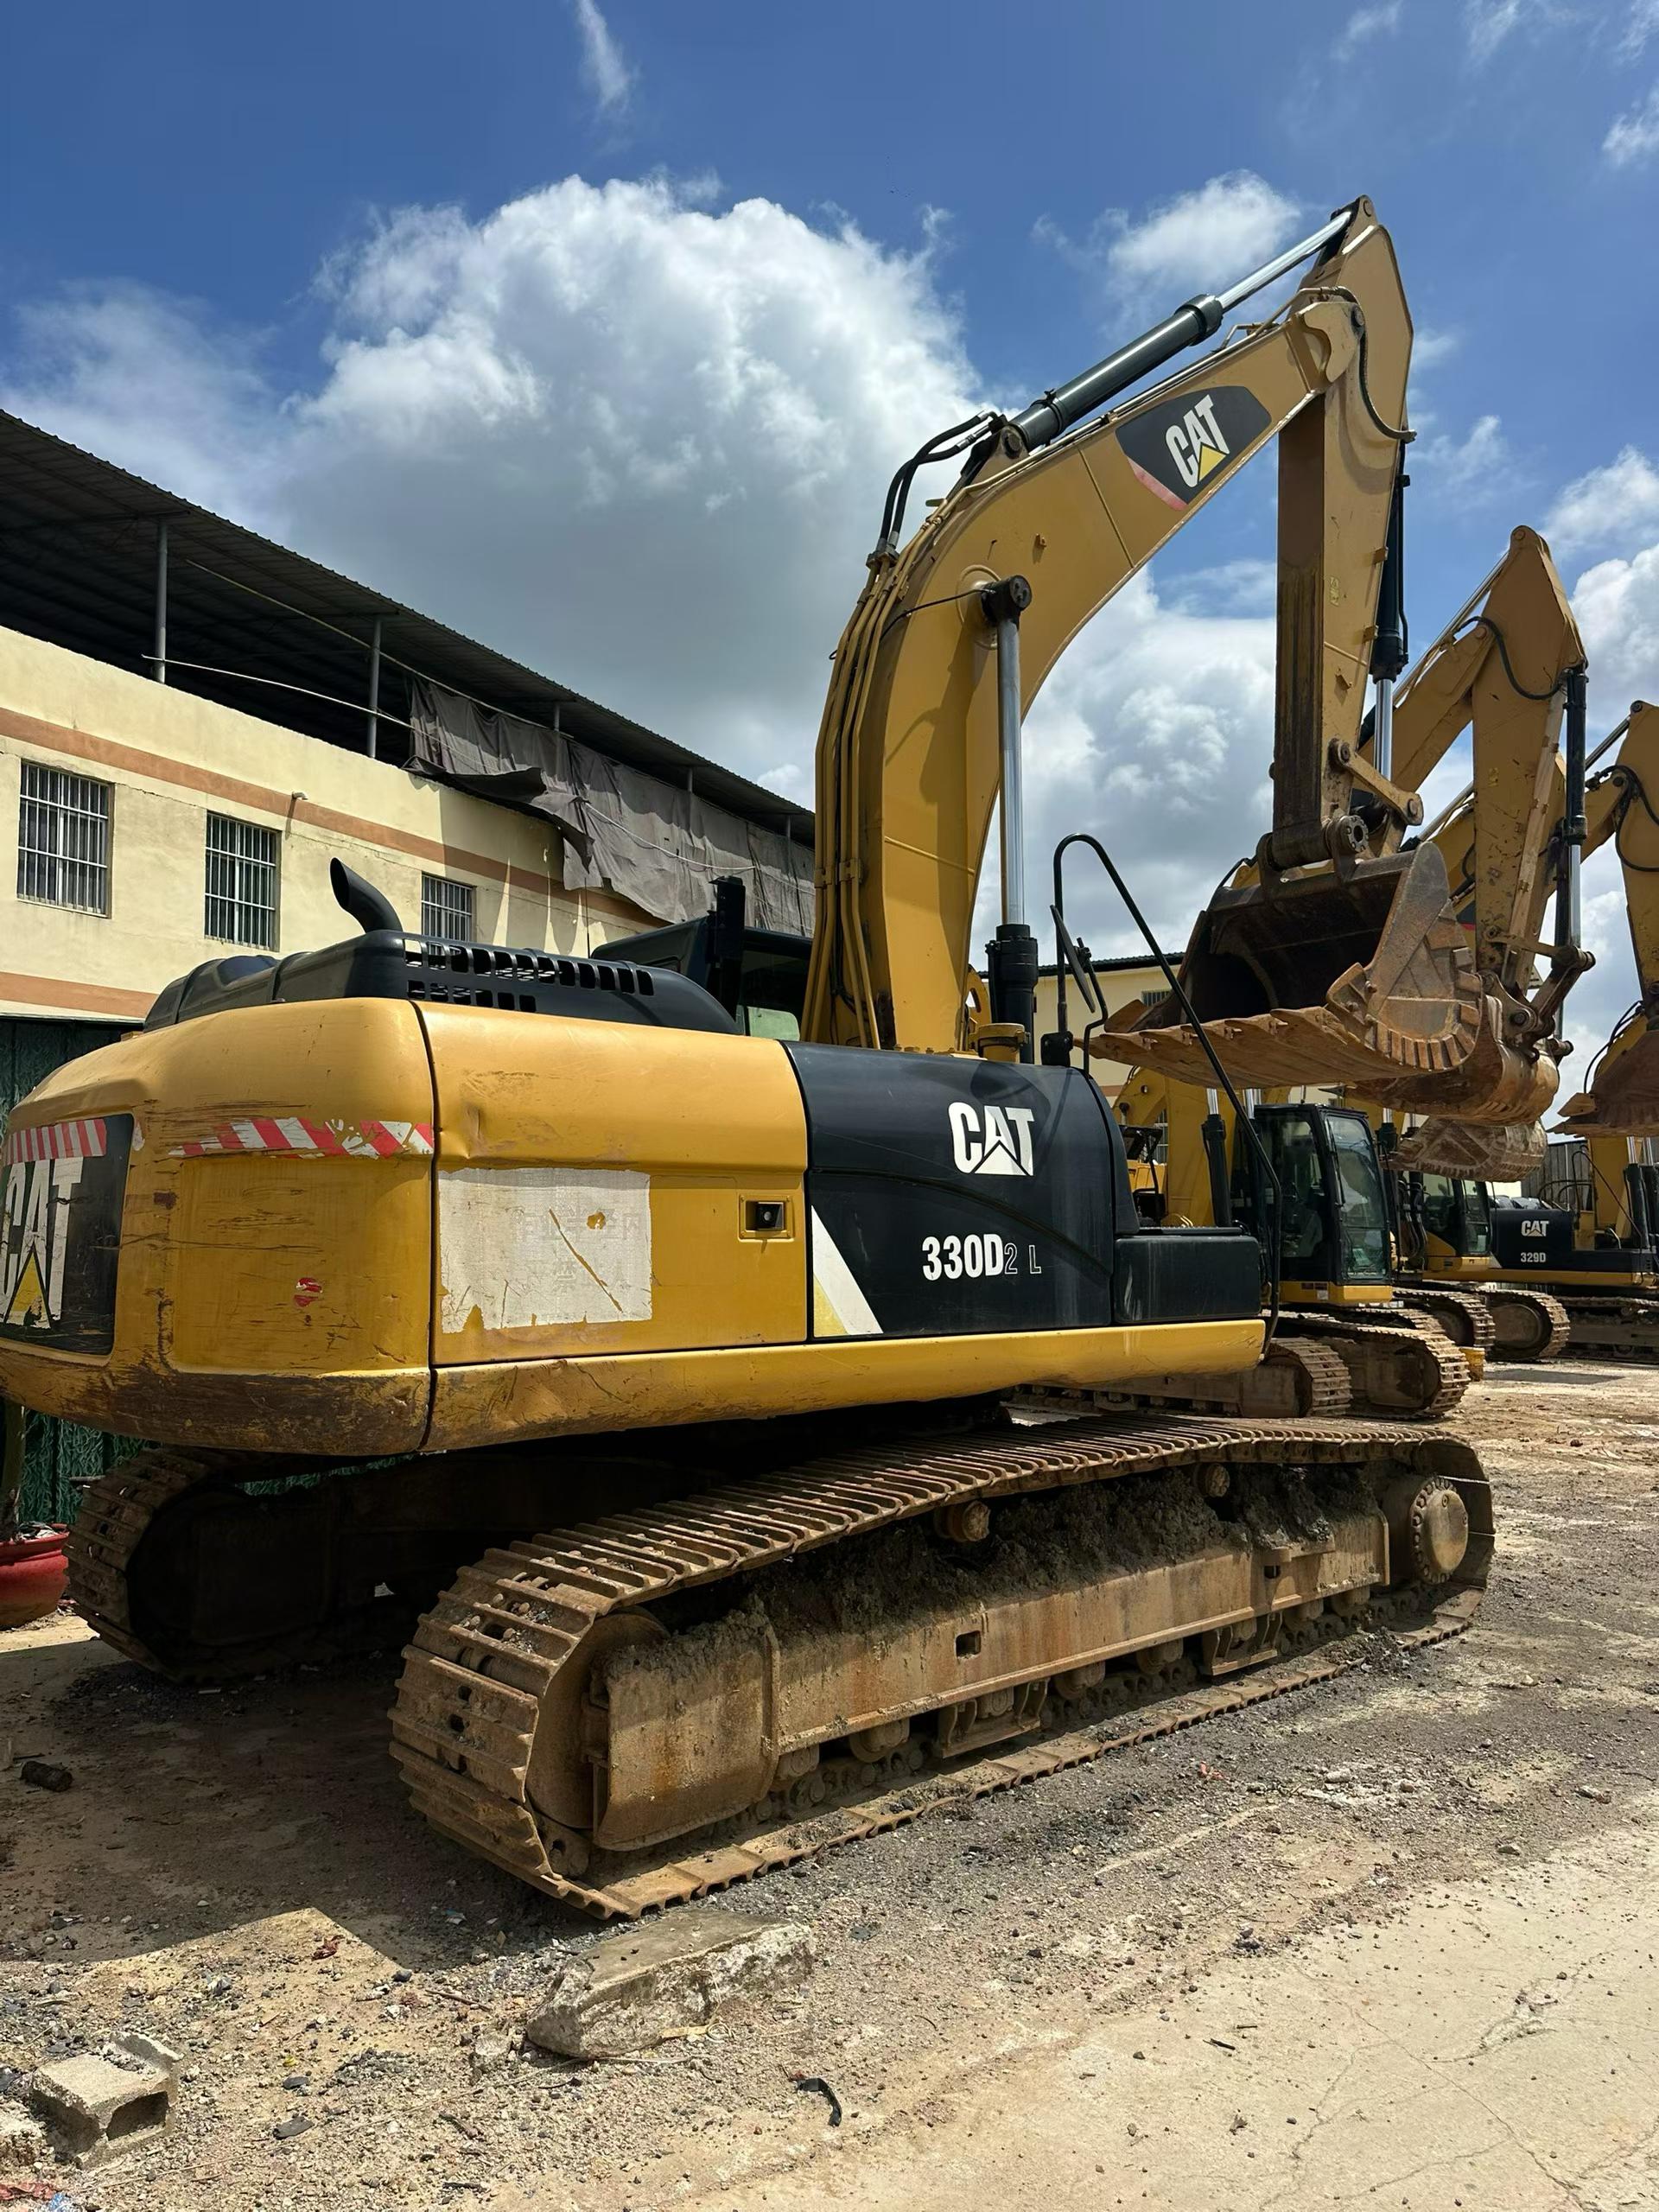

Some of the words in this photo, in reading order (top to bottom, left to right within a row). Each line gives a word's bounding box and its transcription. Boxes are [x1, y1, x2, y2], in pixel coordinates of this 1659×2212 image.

[1166, 394, 1230, 487] CAT
[949, 1102, 1034, 1176] CAT
[0, 1156, 84, 1328] CAT
[1522, 1220, 1549, 1236] CAT
[1028, 1244, 1042, 1274] L
[1521, 1252, 1546, 1262] 329D
